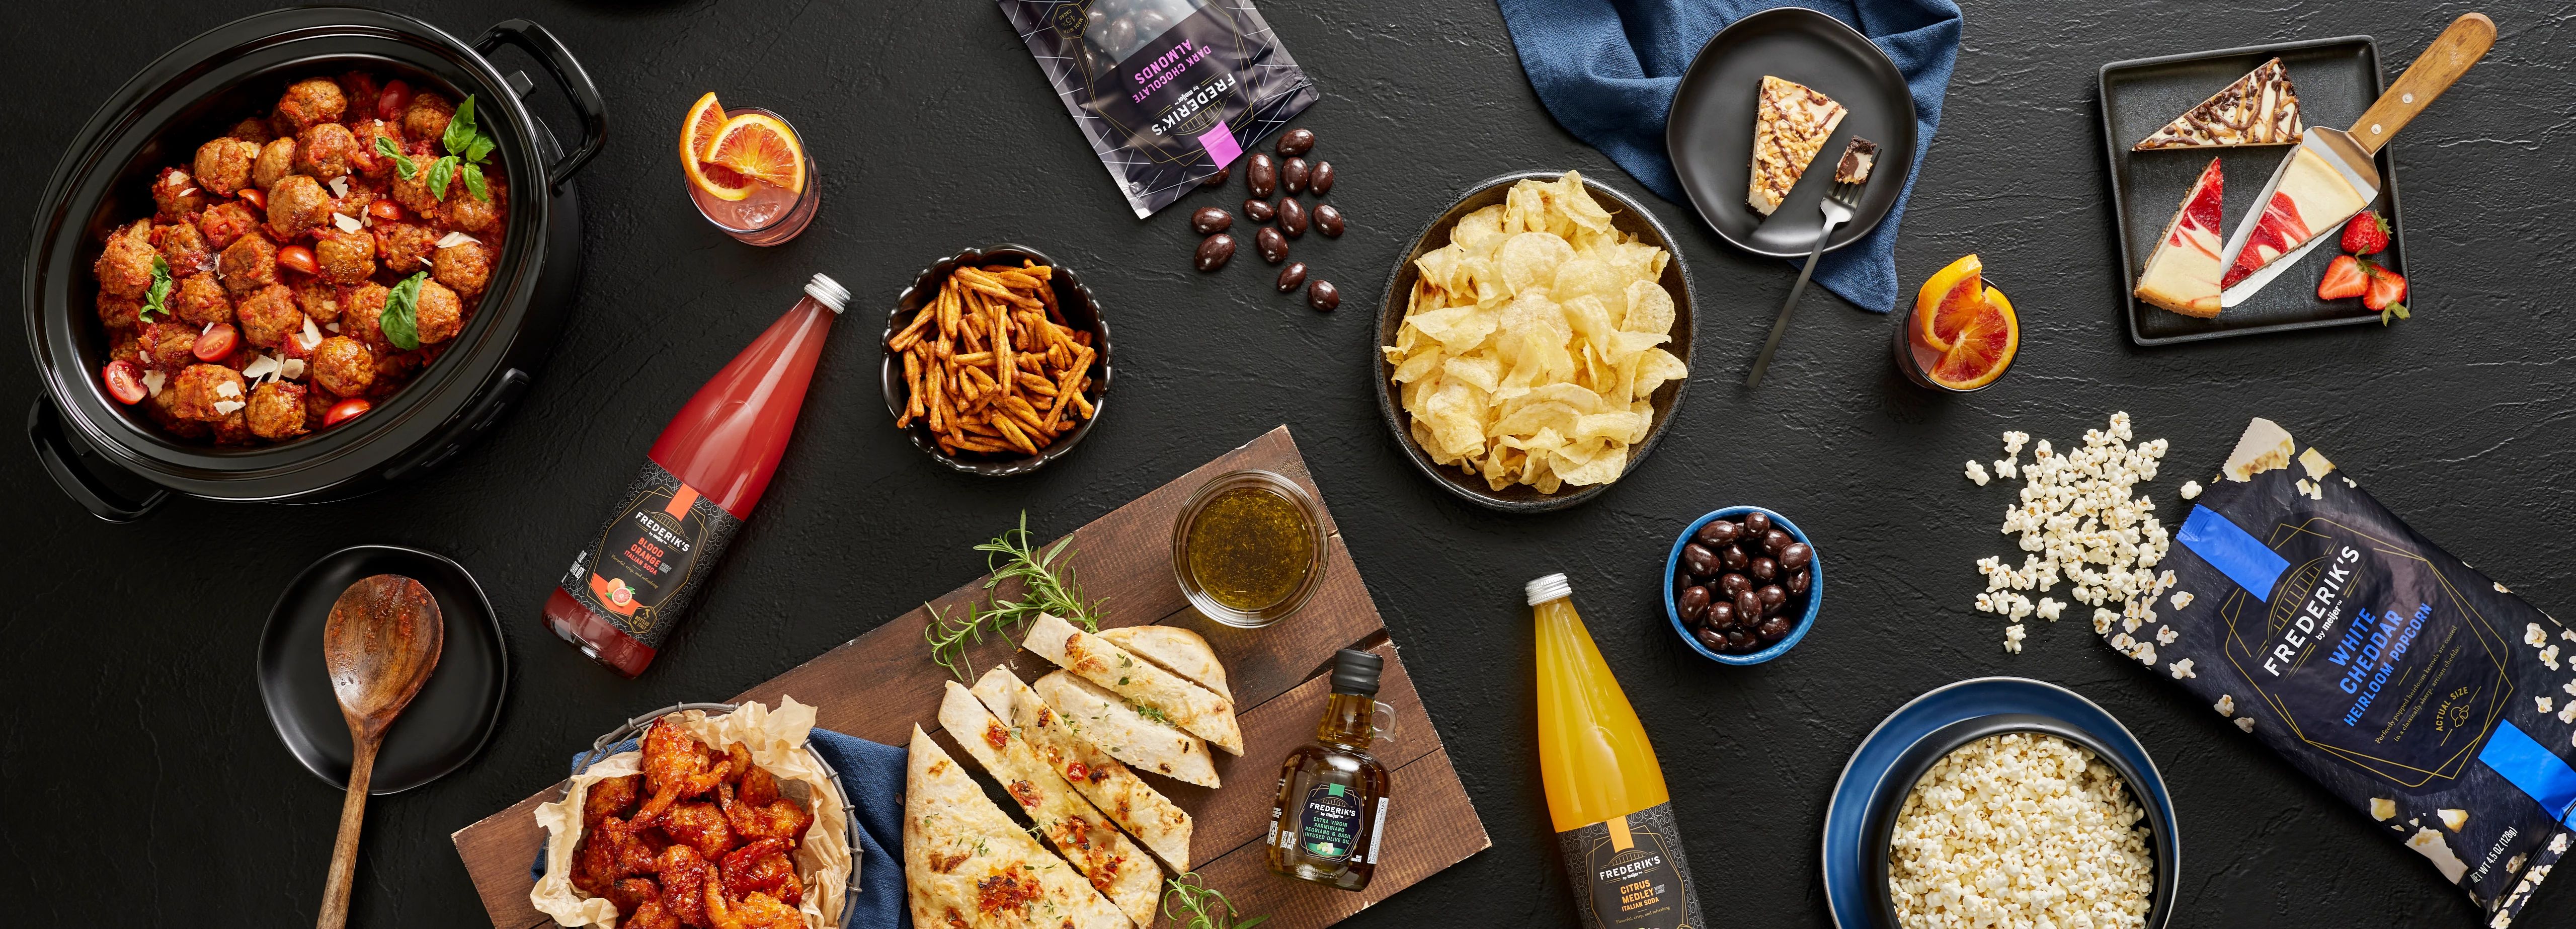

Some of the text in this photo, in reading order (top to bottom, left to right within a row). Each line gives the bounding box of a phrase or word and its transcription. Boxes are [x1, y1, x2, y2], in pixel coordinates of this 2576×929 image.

[1059, 10, 1072, 20] CACAO
[1061, 15, 1075, 28] 45%
[1074, 18, 1083, 29] MADE
[1135, 39, 1192, 84] ALMONDS
[1132, 45, 1212, 103] DARK CHOCOLATE
[1151, 73, 1236, 135] FREDERIK'S
[635, 511, 690, 552] FREDERIK'S
[631, 544, 661, 567] ORANGE
[638, 537, 664, 558] BLOOD
[611, 555, 625, 567] Flavorful,
[624, 550, 658, 575] ITALIAN SODA
[635, 616, 650, 626] BOTTLED
[2264, 546, 2359, 676] FREDERIK'S
[636, 621, 647, 630] ITALY
[2315, 630, 2325, 640] by
[2328, 608, 2376, 666] WHITE
[2340, 610, 2403, 694] CHEDDAR
[2344, 603, 2433, 727] HEIRLOOM POPCORN
[2375, 720, 2395, 743] Perfectly
[2393, 699, 2409, 721] popped
[2406, 674, 2426, 699] heirloom
[2424, 654, 2439, 673] kernels
[2445, 625, 2457, 644] coated
[2402, 705, 2422, 730] classically
[2420, 688, 2433, 705] sharp,
[2432, 668, 2446, 686] artisan
[2445, 645, 2461, 667] cheddar.
[2436, 686, 2468, 731] ACTUAL SIZE
[1310, 803, 1355, 816] FREDERIK'S
[1305, 827, 1330, 835] REGGIANO
[1314, 823, 1344, 832] PARMIGIANO
[2470, 826, 2518, 883] NET WT 4.5 OZ (128g)
[1599, 856, 1660, 880] FREDERIK'S
[1621, 880, 1650, 894] CITRUS
[1622, 888, 1653, 903] MEDLEY
[1622, 897, 1659, 911] ITALIAN SODA
